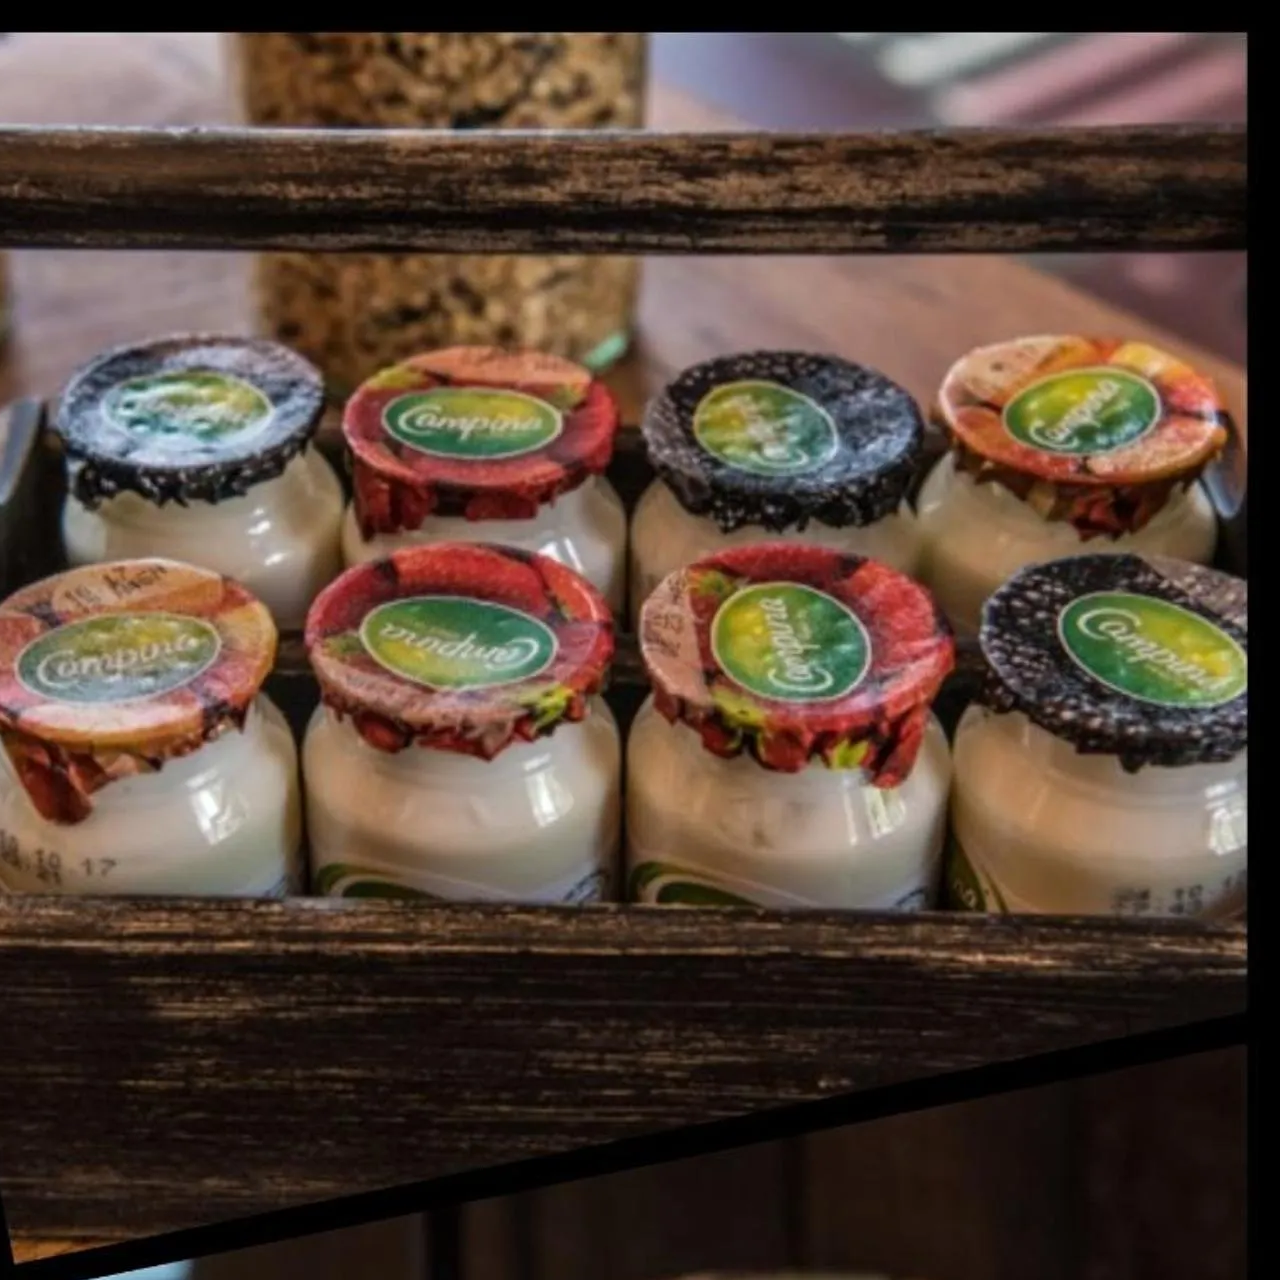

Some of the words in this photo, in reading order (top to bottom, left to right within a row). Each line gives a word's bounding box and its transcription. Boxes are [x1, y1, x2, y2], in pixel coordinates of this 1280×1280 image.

[397, 403, 543, 441] Campina
[379, 623, 540, 672] Campina
[760, 597, 834, 692] Campina
[1076, 607, 1235, 692] Campina
